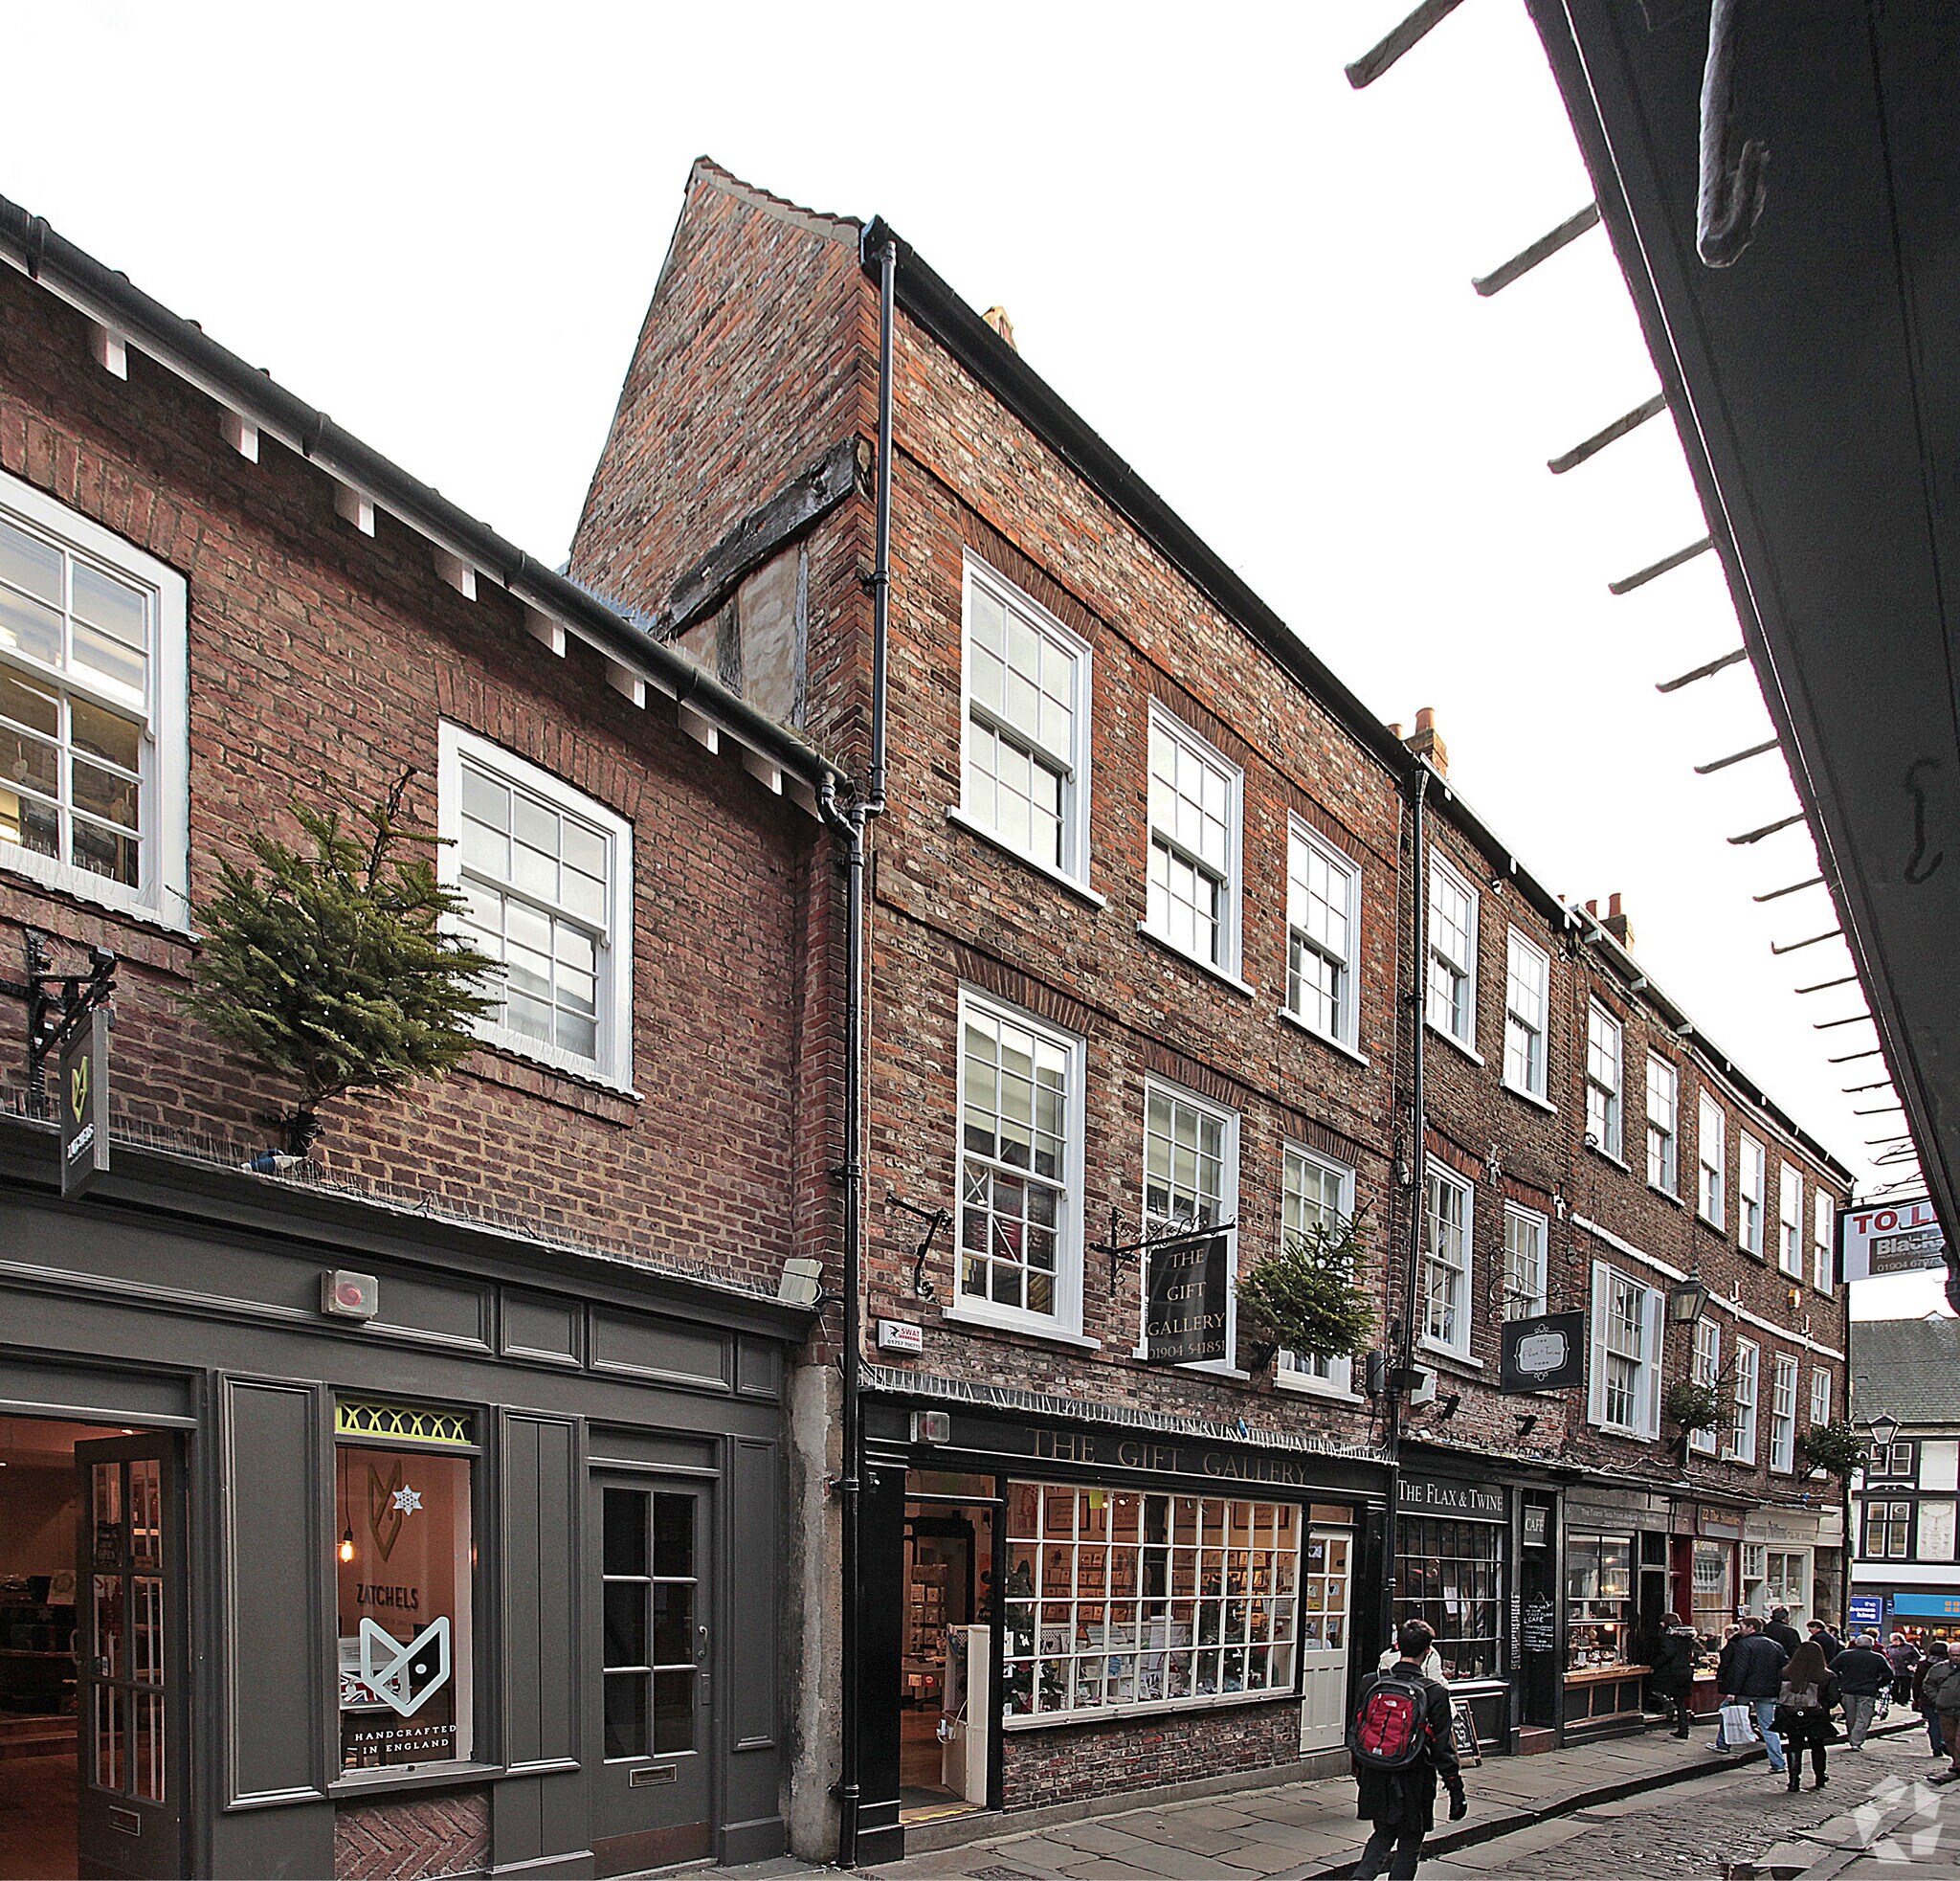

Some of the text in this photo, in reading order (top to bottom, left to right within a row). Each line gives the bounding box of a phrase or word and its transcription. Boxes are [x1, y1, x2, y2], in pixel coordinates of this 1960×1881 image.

[1853, 1211, 1898, 1234] TO
[1169, 1248, 1205, 1267] THE
[1877, 1262, 1908, 1271] 01904
[1168, 1282, 1207, 1301] GIFT
[901, 1328, 920, 1337] SWAT
[1147, 1312, 1225, 1336] GALLERY
[1188, 1340, 1225, 1355] 541851
[1026, 1427, 1309, 1484] THE GIFT GALLERY
[1459, 1491, 1467, 1508] &
[356, 1583, 419, 1610] ZATCHELS
[355, 1725, 457, 1741] HANDCRAFTED
[363, 1739, 449, 1755] IN ENGLAND
